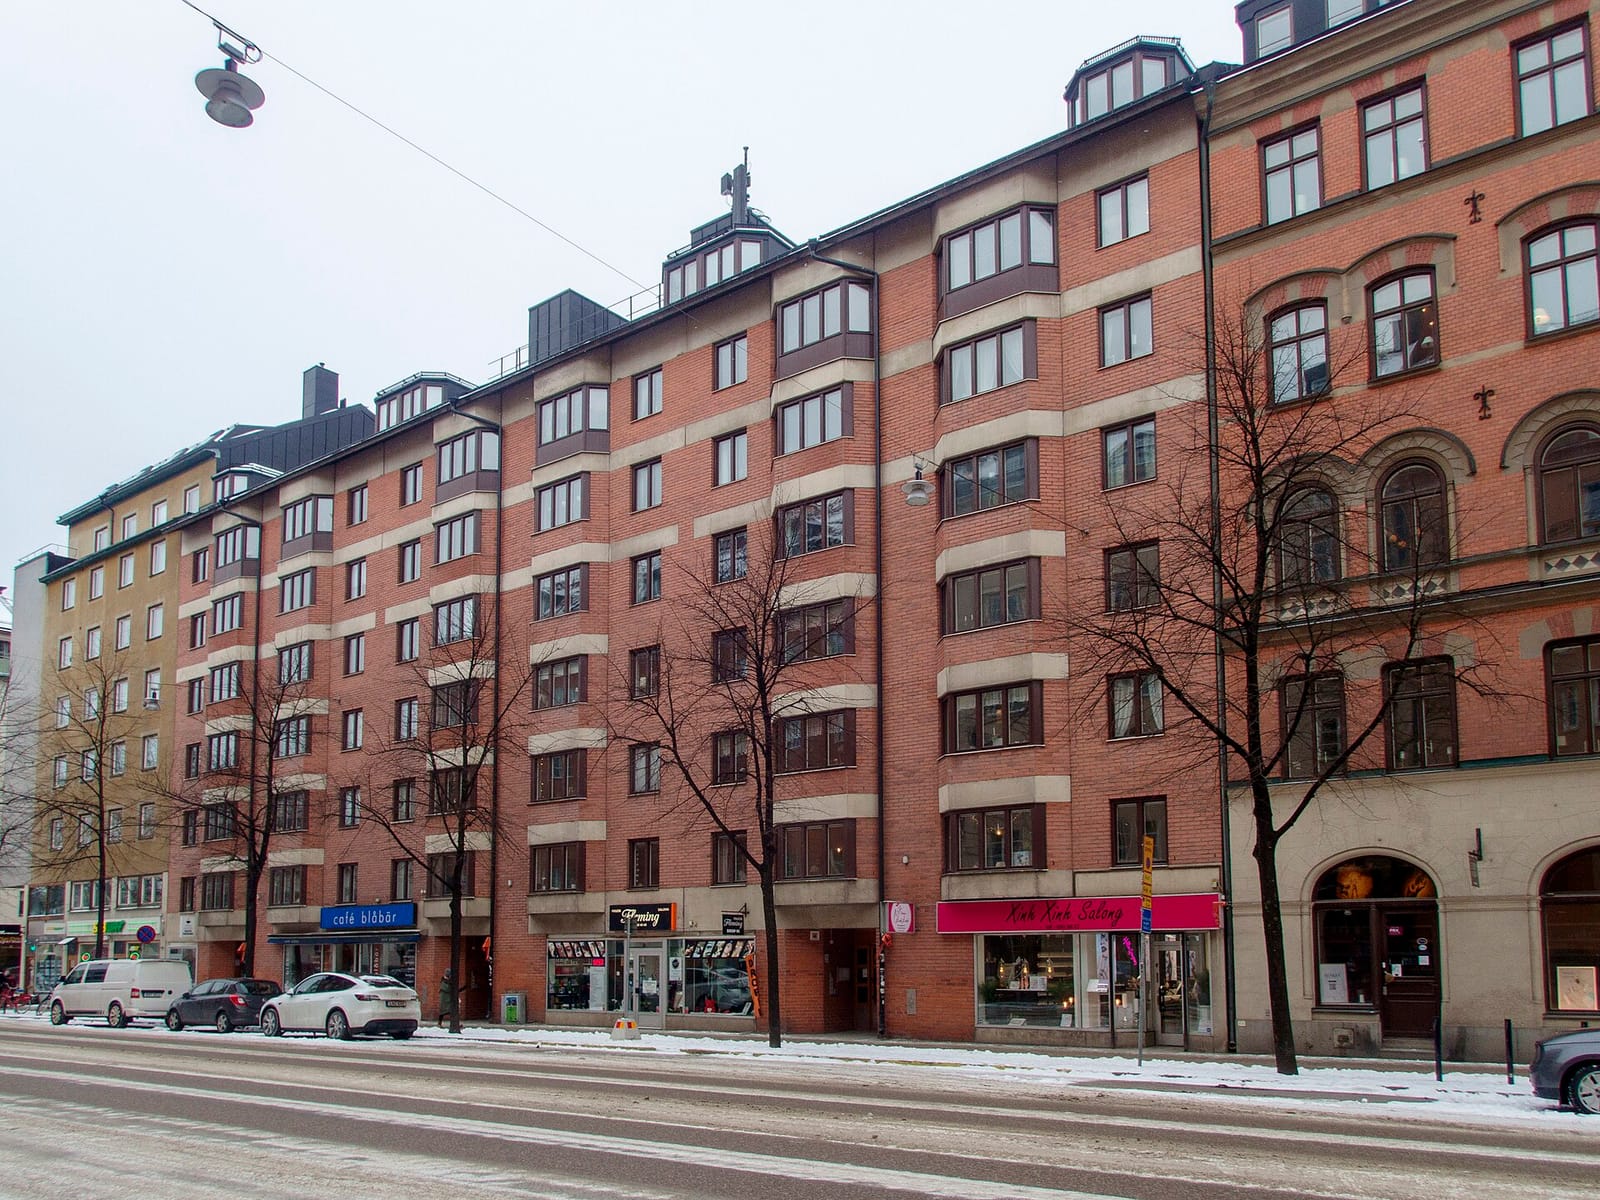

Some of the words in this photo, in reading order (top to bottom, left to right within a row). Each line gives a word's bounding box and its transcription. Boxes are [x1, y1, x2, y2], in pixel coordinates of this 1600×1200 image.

[333, 911, 355, 925] café
[361, 910, 397, 924] blåbär
[1006, 902, 1035, 924] Xinh
[1040, 900, 1071, 922] Xinh
[1078, 900, 1123, 927] Salong
